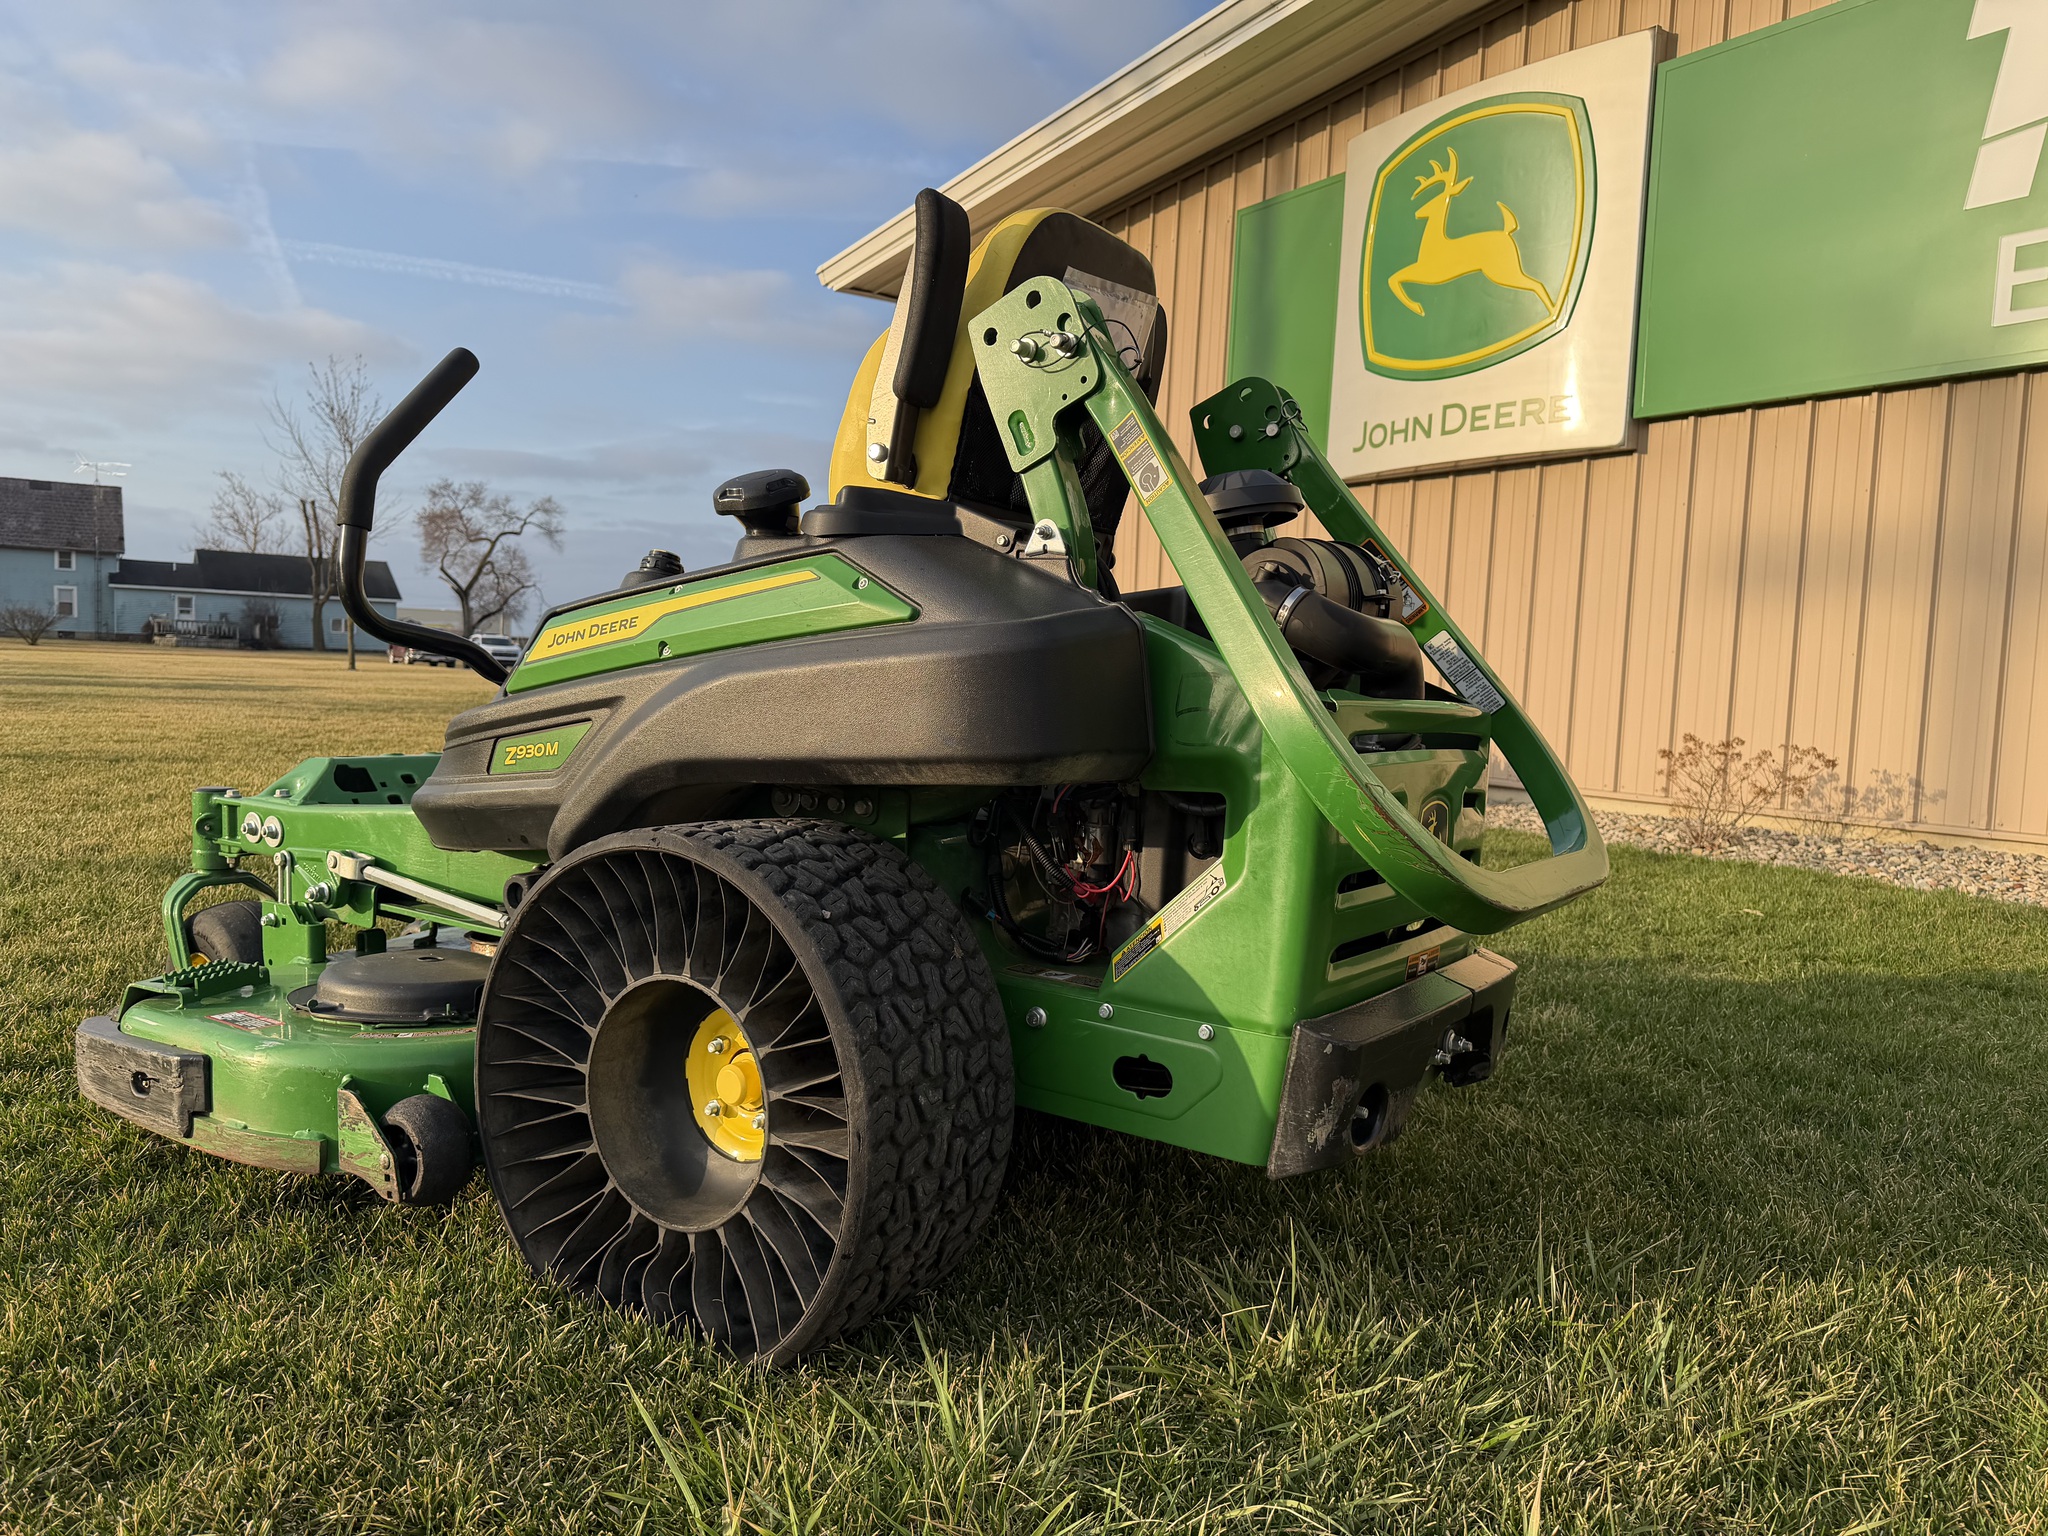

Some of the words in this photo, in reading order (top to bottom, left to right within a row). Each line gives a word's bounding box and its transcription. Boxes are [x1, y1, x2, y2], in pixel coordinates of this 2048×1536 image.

[1352, 413, 1433, 453] JOHN
[1440, 395, 1573, 438] DEERE
[547, 629, 586, 648] JOHN
[588, 616, 639, 638] DEERE
[504, 741, 559, 765] Z930M
